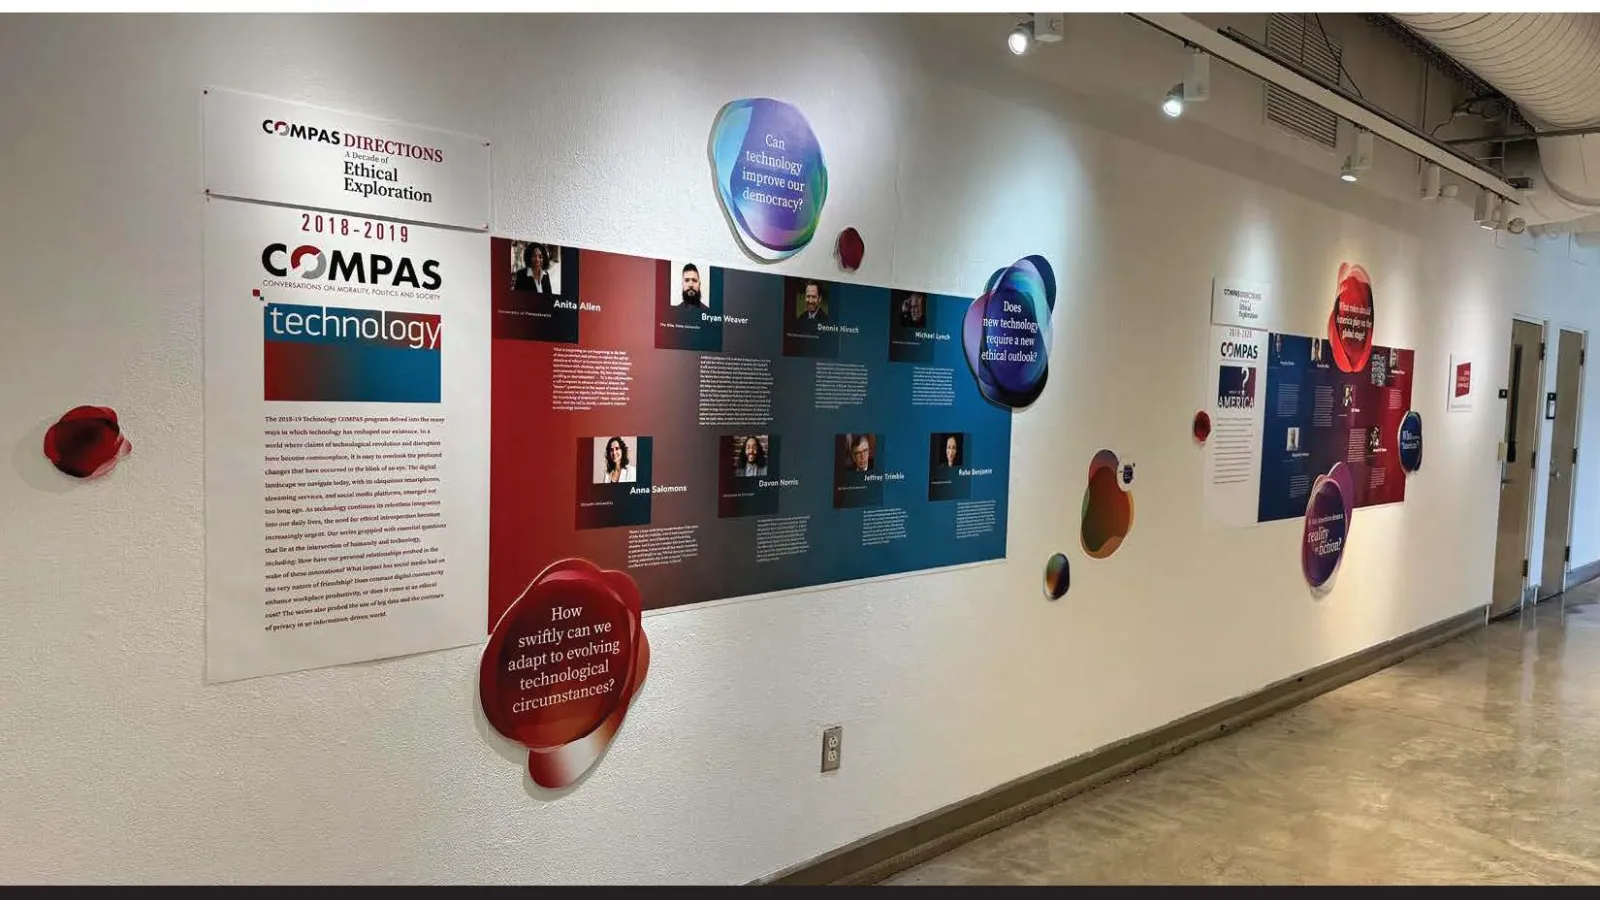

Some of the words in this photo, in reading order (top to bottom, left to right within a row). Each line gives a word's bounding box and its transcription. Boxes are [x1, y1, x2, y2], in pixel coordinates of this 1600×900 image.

[263, 120, 340, 145] COMPAS
[344, 133, 443, 162] DIRECTIONS
[766, 134, 785, 150] Can
[352, 152, 379, 163] Decade
[746, 150, 802, 176] technology
[344, 161, 398, 182] Ethical
[742, 167, 785, 187] improve
[787, 180, 805, 192] our
[344, 178, 432, 202] Exploration
[742, 187, 804, 212] democracy?
[302, 214, 408, 242] 2018-2019
[262, 243, 442, 290] COMPAS
[263, 280, 322, 291] CONVERSATIONS
[337, 286, 370, 295] MORALITY,
[372, 288, 398, 297] POLITICS
[554, 300, 577, 310] Anita
[580, 301, 601, 312] Allen
[1003, 301, 1022, 313] Does
[701, 313, 721, 324] Bryan
[723, 315, 748, 324] Weaver
[983, 318, 999, 327] new
[1001, 318, 1038, 333] technology
[270, 306, 444, 349] technology
[817, 324, 838, 332] Dennis
[840, 325, 859, 334] Hirsch
[915, 331, 934, 340] Michael
[986, 334, 1013, 347] require
[1021, 338, 1035, 346] new
[981, 350, 1006, 361] ethical
[1008, 352, 1038, 362] outlook?
[1221, 342, 1258, 359] COMPAS
[1218, 395, 1255, 409] AMERICA
[759, 479, 779, 488] Davon
[780, 478, 798, 486] Norris
[864, 473, 883, 482] Jeffrey
[629, 486, 650, 495] Anna
[652, 485, 687, 493] Salomons
[1308, 526, 1329, 543] reality
[1319, 537, 1342, 555] fiction?
[551, 606, 582, 621] How
[518, 628, 564, 648] swiftly
[567, 627, 590, 638] can
[594, 621, 612, 633] we
[508, 654, 547, 672] adapt
[550, 651, 562, 664] to
[566, 640, 620, 660] evolving
[520, 659, 609, 691] technological
[512, 678, 615, 713] circumstances?
